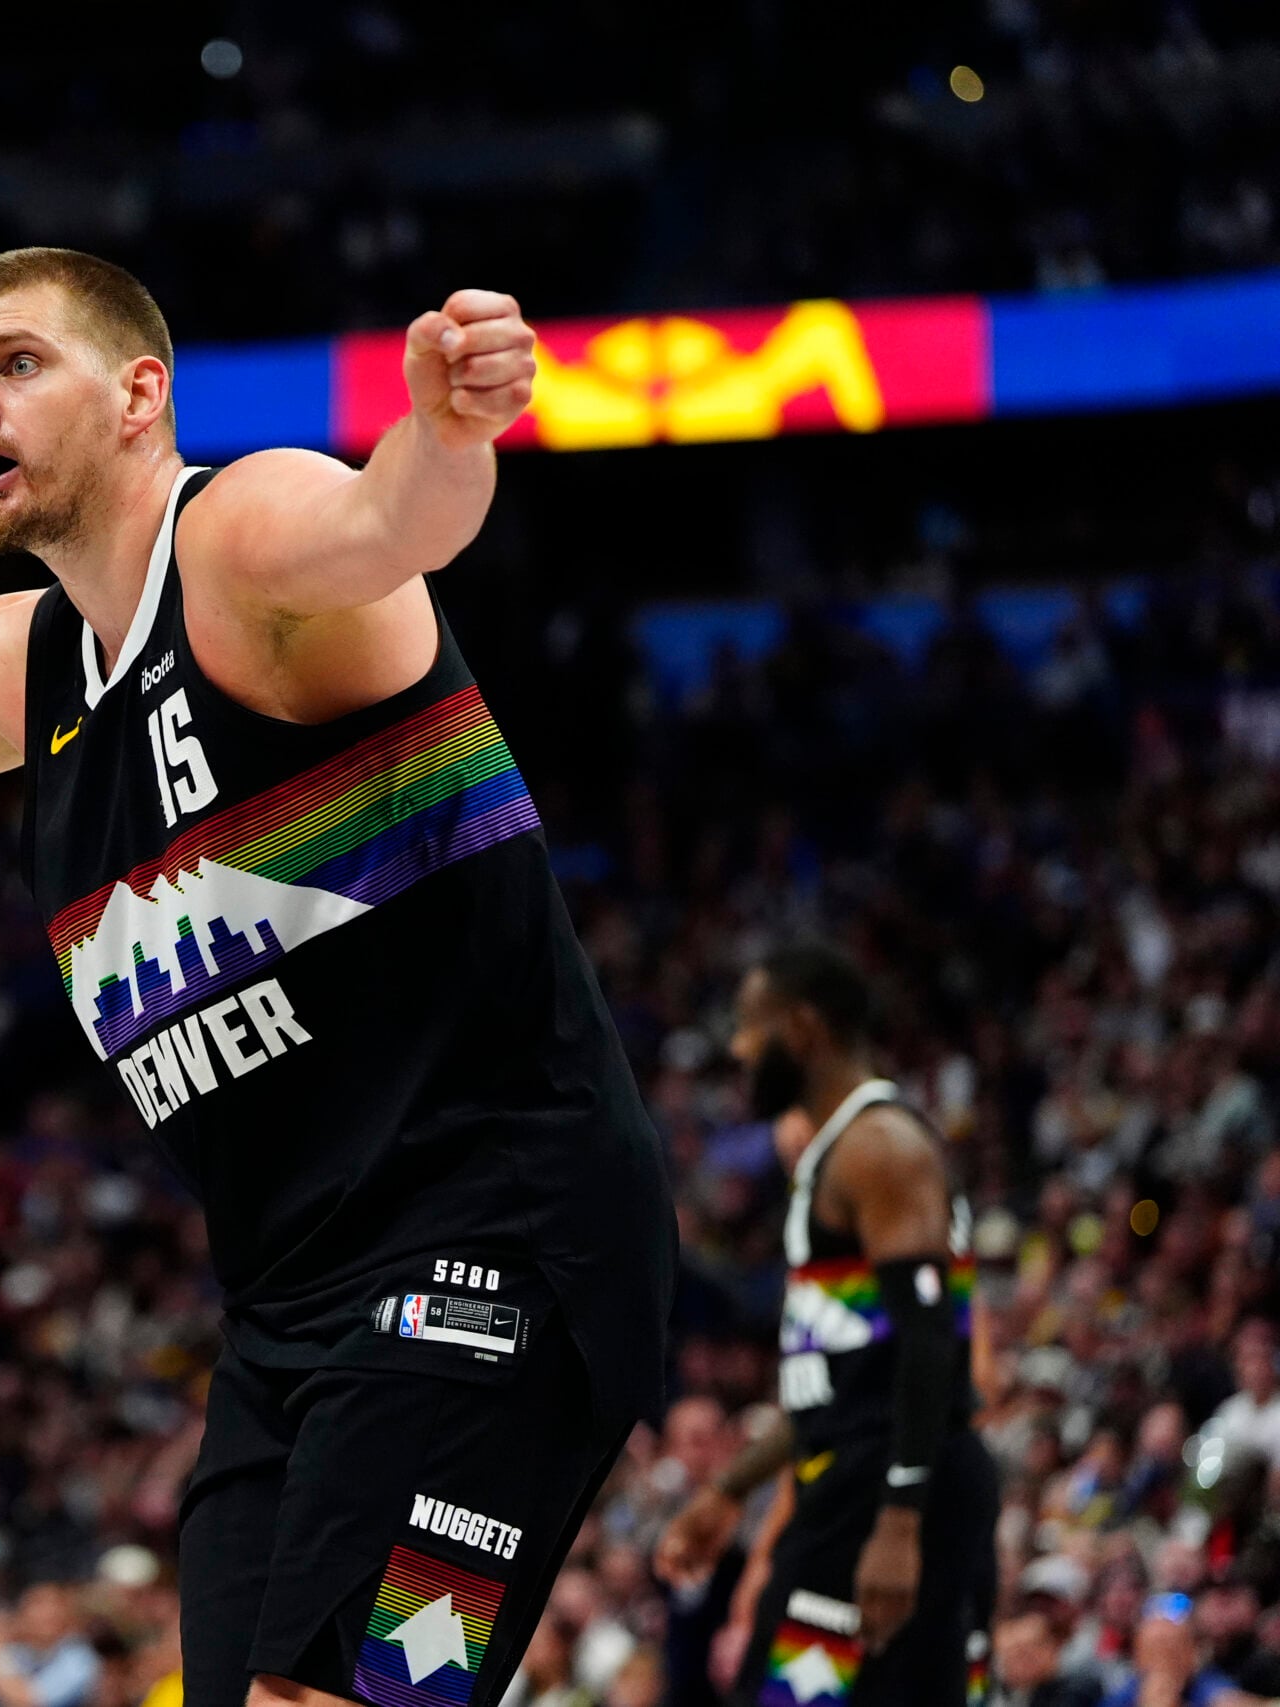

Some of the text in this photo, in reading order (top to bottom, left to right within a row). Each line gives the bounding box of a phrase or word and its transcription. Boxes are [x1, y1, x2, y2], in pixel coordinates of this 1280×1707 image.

[141, 650, 175, 695] ibotta
[148, 687, 219, 829] 15
[117, 977, 313, 1131] DENVER
[433, 1259, 500, 1291] 5280
[430, 1307, 442, 1316] 58
[409, 1493, 523, 1560] NUGGETS
